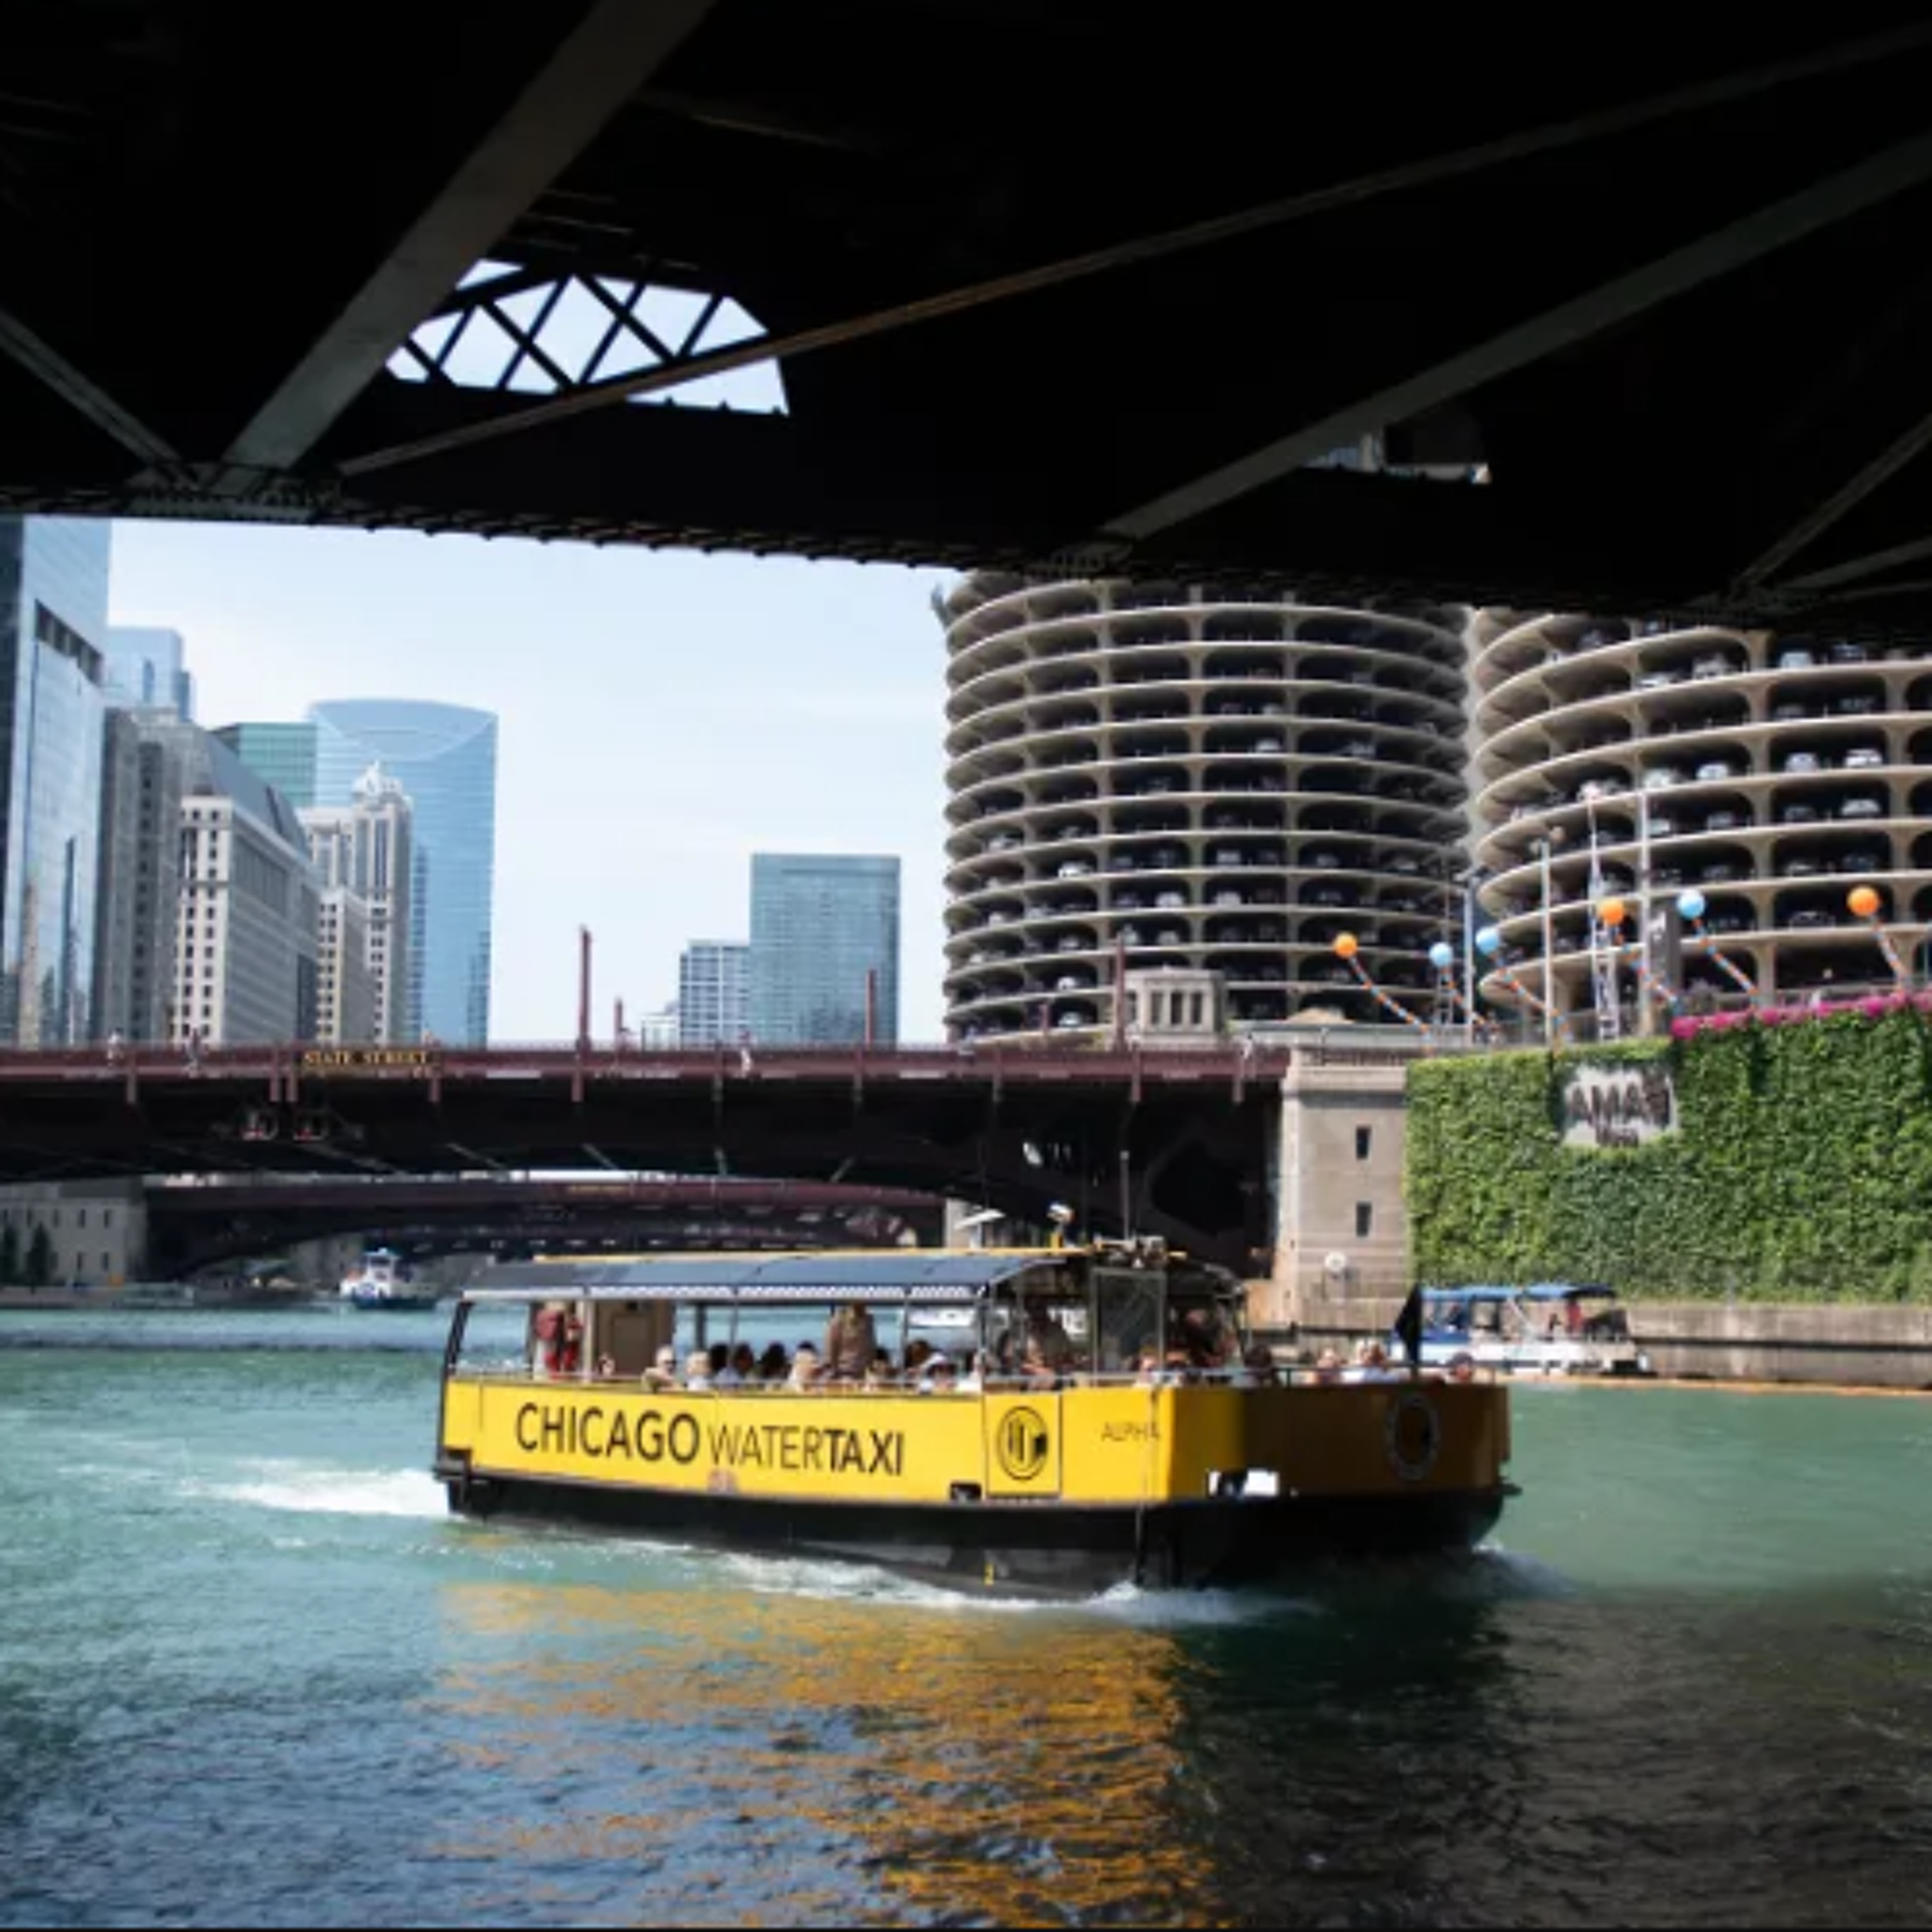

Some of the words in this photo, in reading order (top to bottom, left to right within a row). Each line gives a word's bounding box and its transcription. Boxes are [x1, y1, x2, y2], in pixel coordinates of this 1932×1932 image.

[304, 1050, 350, 1065] STATE
[362, 1050, 427, 1065] STREET
[516, 1401, 701, 1465] CHICAGO
[1101, 1421, 1160, 1442] ALPHA
